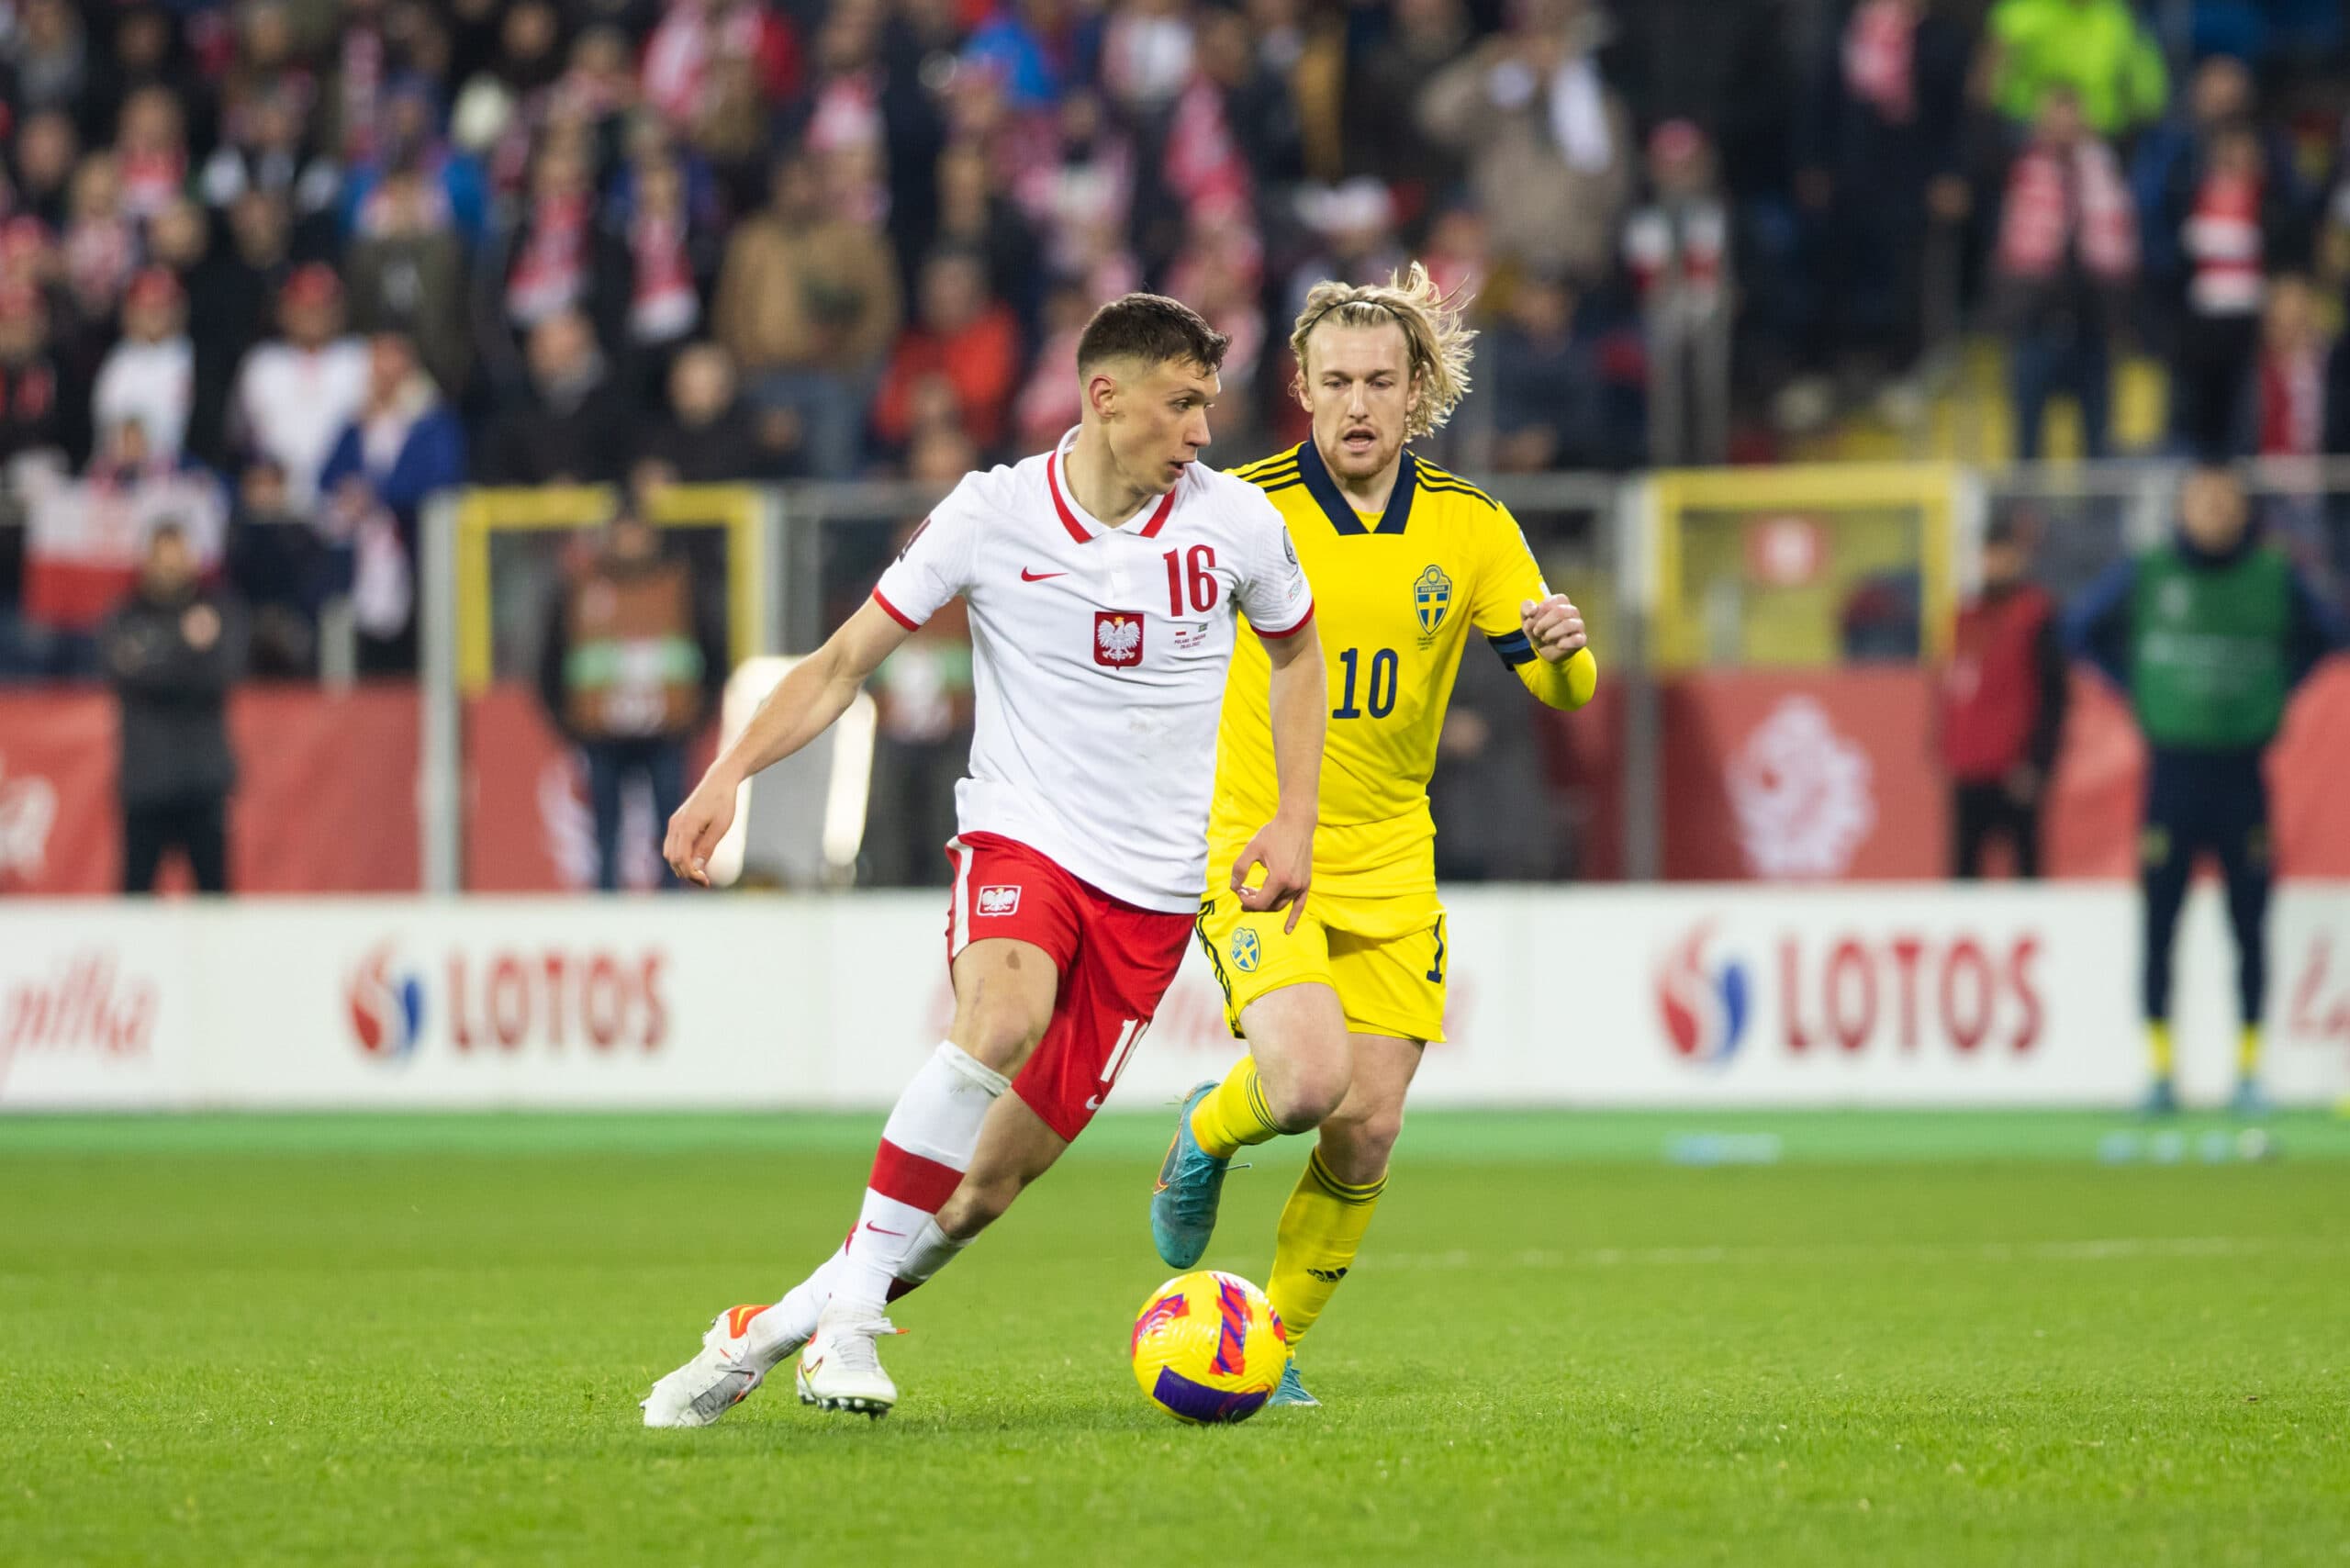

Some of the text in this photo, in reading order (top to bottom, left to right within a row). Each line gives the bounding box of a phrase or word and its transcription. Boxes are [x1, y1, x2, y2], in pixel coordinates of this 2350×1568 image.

[1162, 544, 1219, 617] 16
[1332, 647, 1399, 719] 10
[445, 949, 670, 1054] LOTOS
[1777, 935, 2045, 1054] LOTOS
